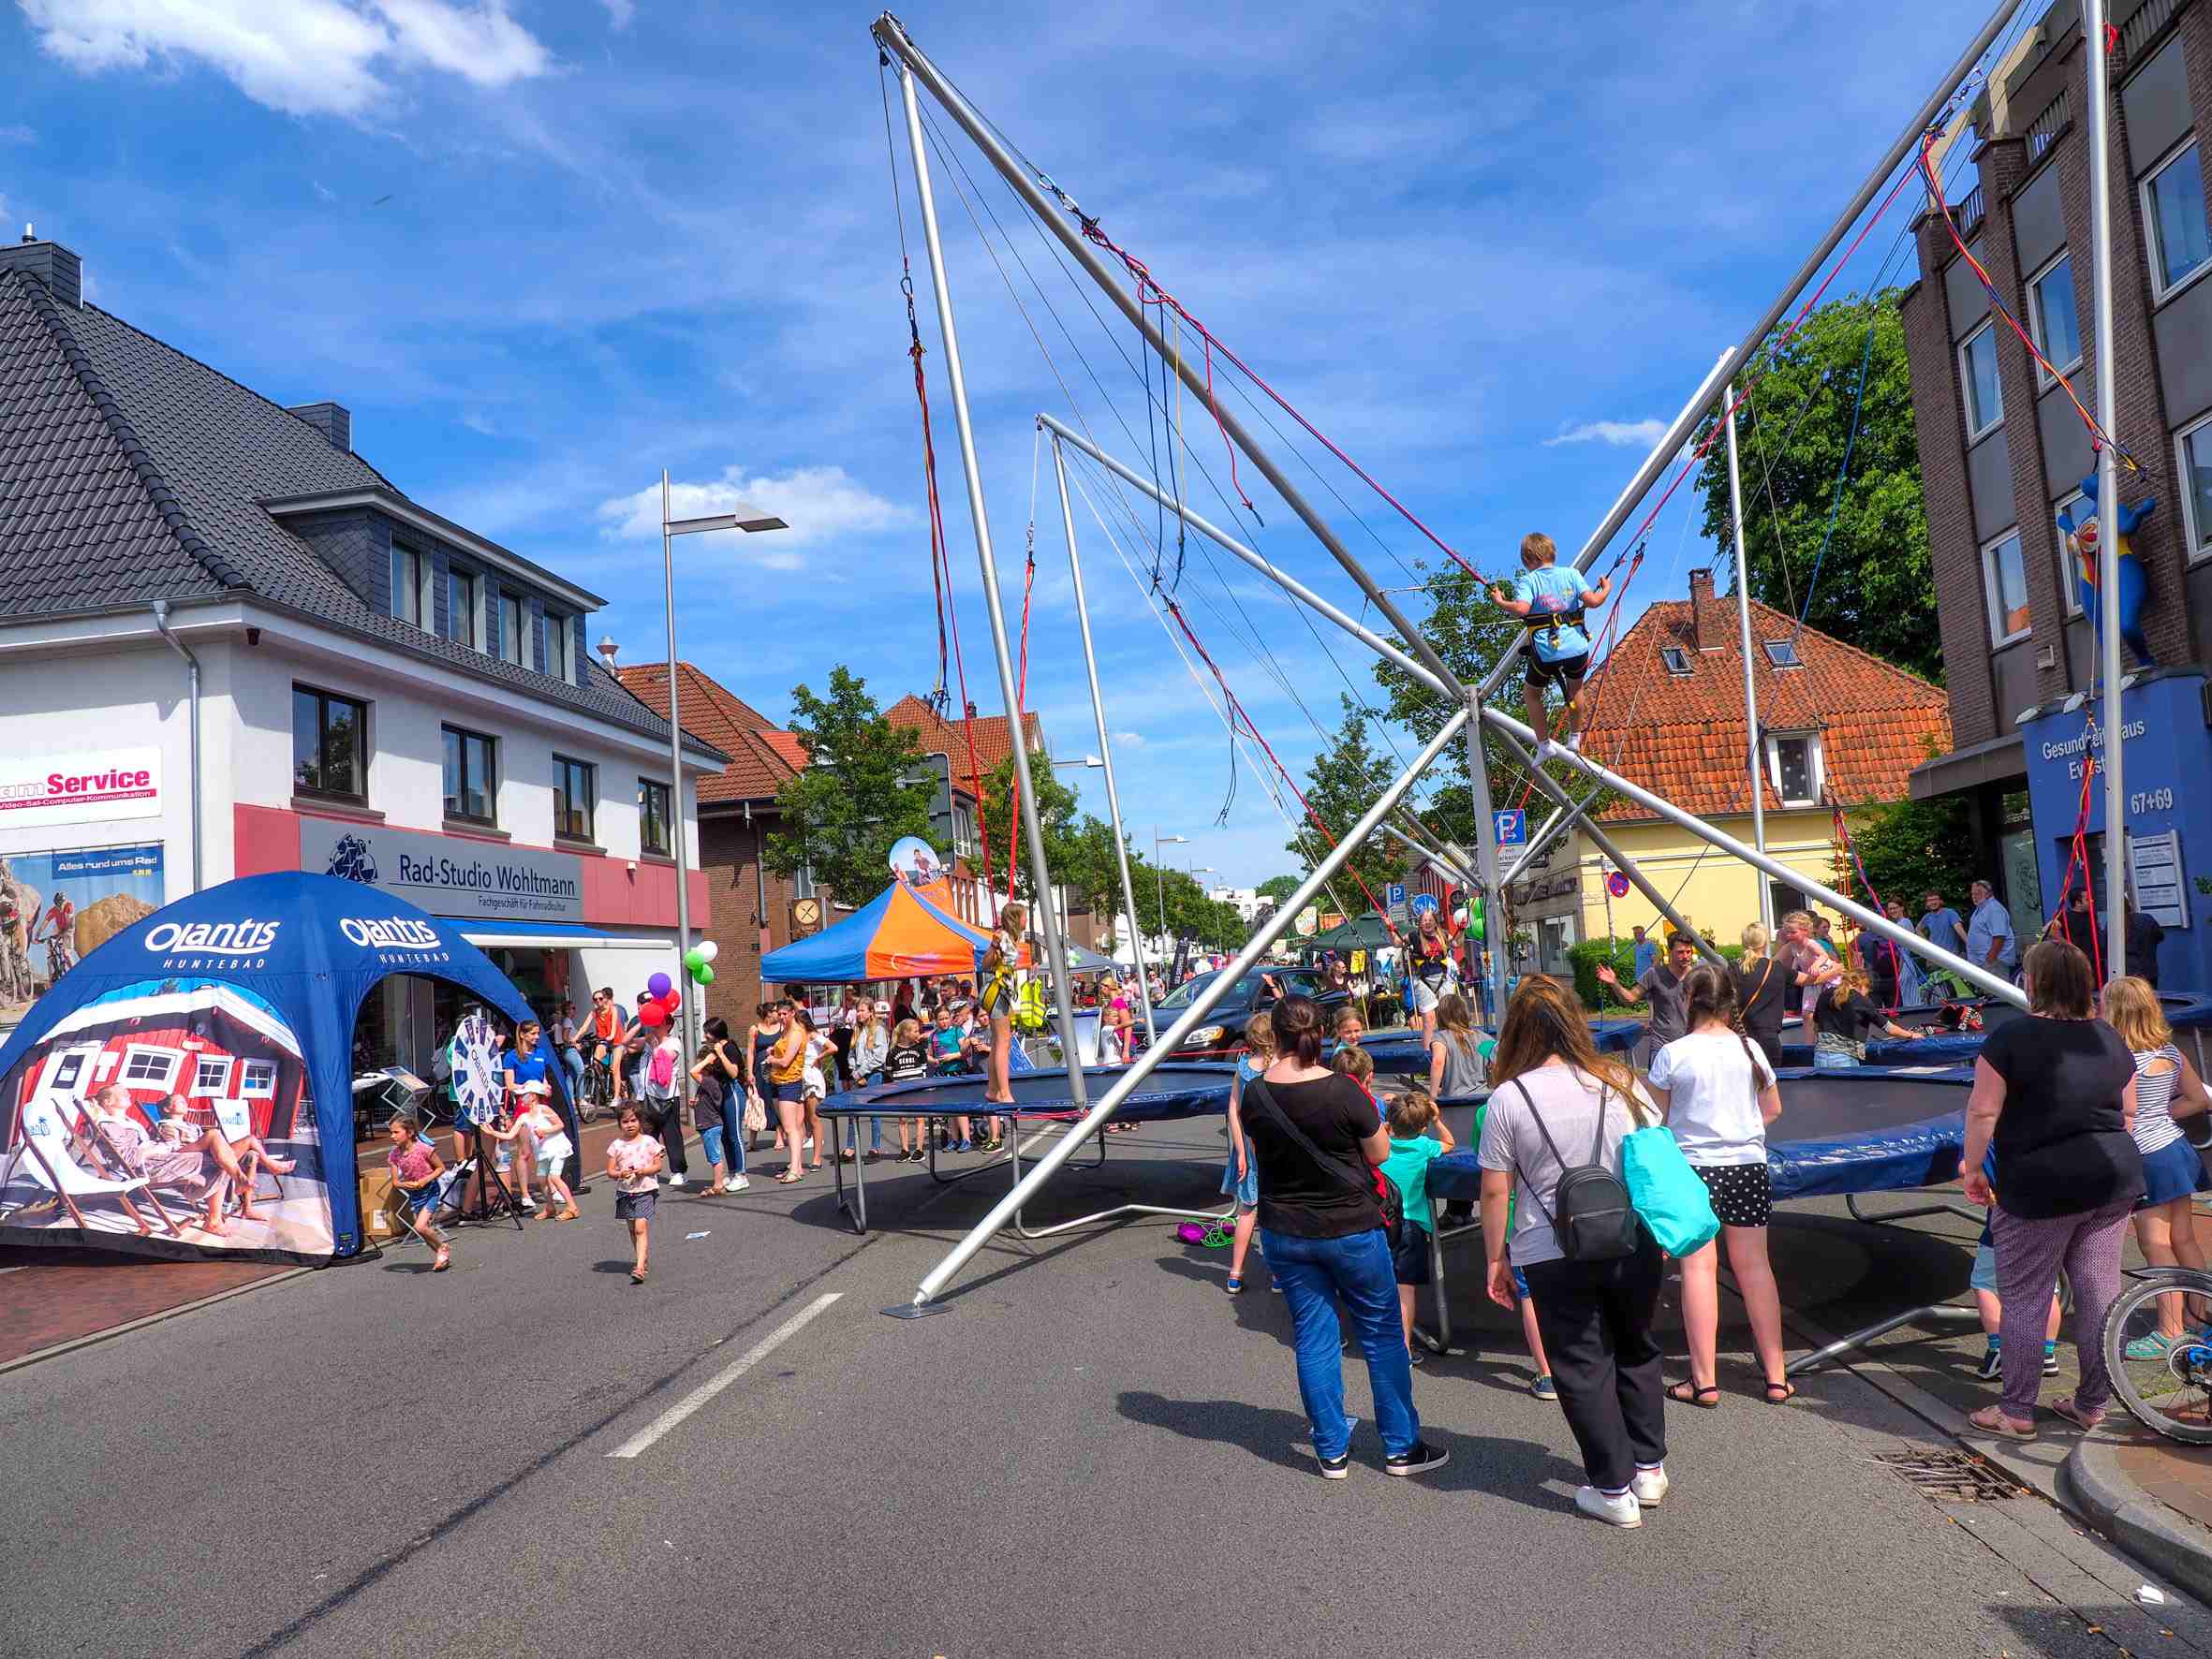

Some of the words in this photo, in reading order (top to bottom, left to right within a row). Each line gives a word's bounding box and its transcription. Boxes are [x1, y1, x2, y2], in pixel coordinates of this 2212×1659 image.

[2131, 787, 2173, 815] 67+69
[58, 861, 84, 872] Alles
[85, 859, 110, 869] rund
[135, 856, 157, 865] Rad
[400, 854, 492, 888] Rad-Studio
[496, 865, 575, 896] Wohltmann
[163, 959, 265, 969] HUNTEBAD
[379, 952, 450, 964] HUNTEBAD
